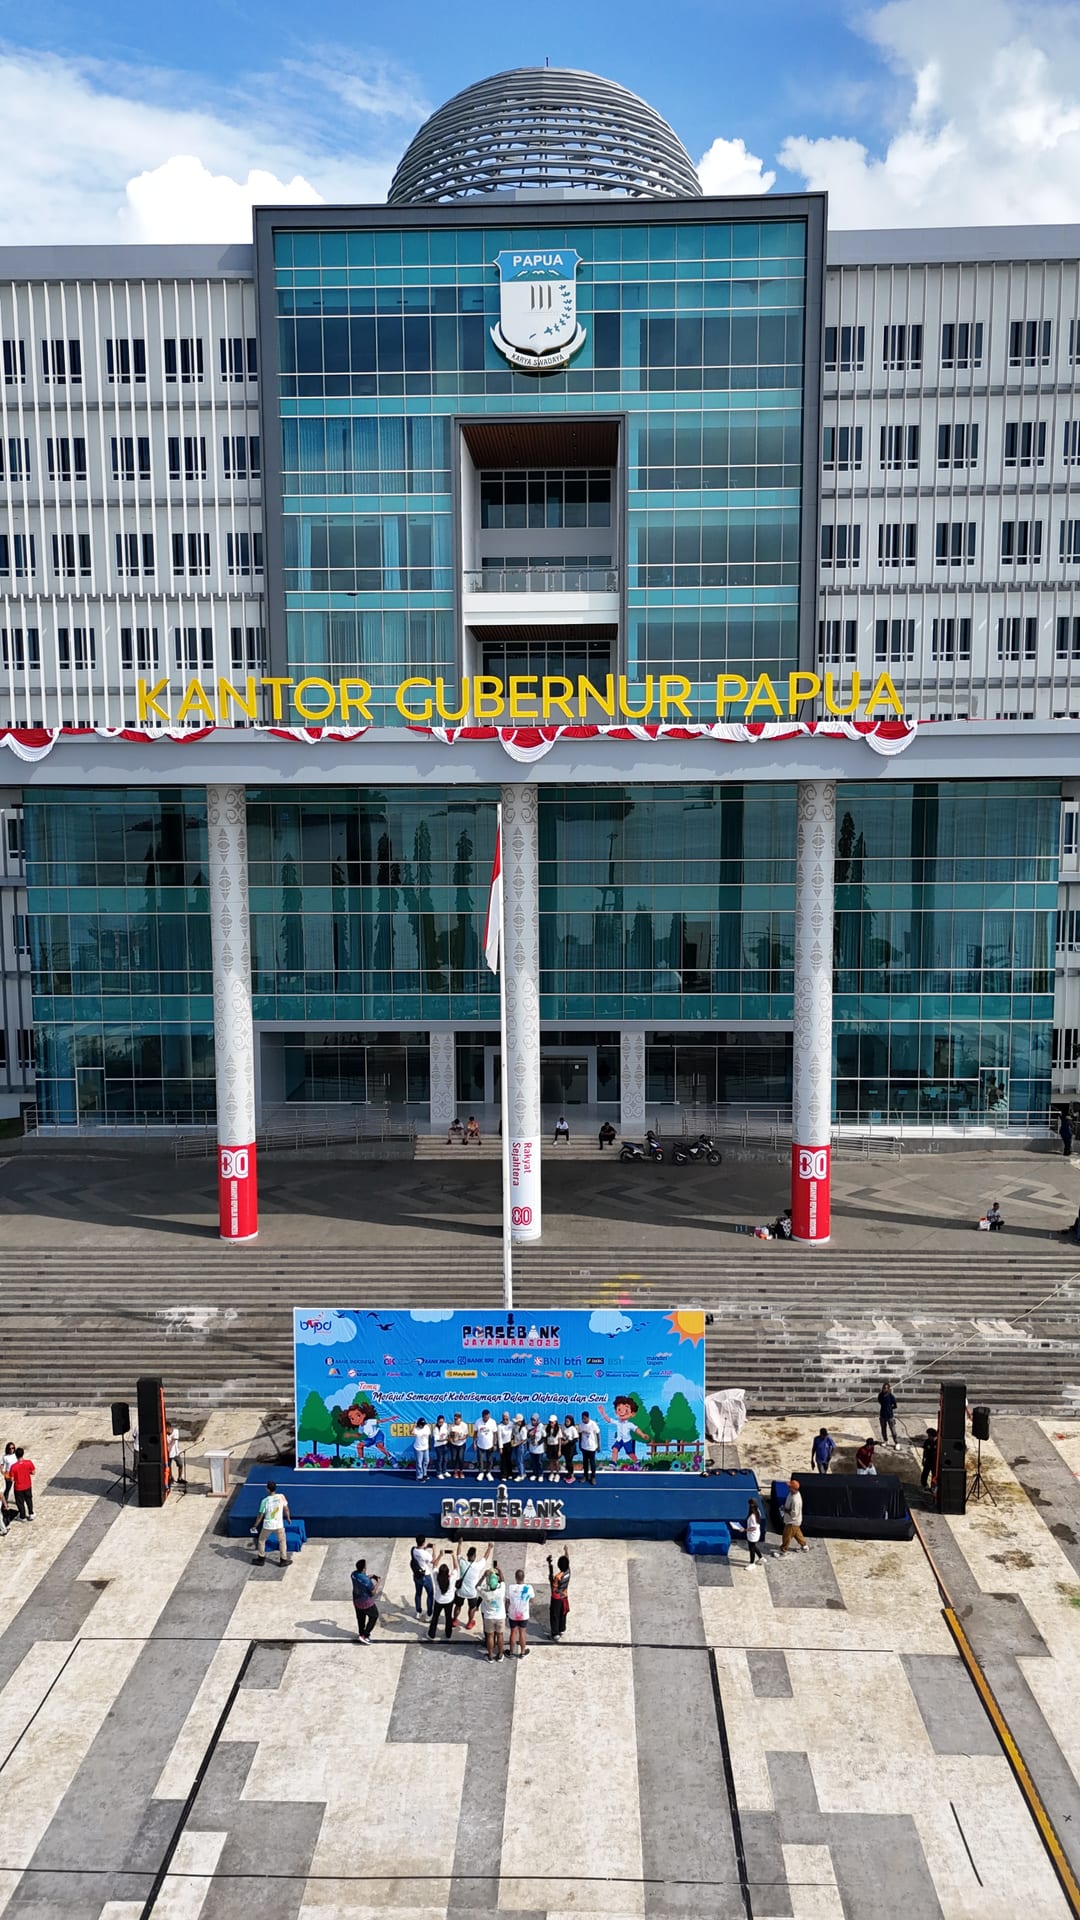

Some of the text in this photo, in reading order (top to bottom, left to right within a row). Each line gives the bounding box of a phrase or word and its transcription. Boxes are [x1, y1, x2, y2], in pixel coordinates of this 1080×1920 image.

[513, 254, 563, 267] PAPUA
[511, 353, 564, 366] KARYA SWADAYA
[138, 671, 905, 721] KANTOR GUBERNUR PAPUA
[512, 1142, 521, 1186] Sejahtera
[522, 1142, 532, 1174] Rakyat
[543, 1357, 560, 1365] BNI
[564, 1356, 582, 1365] btn
[359, 1382, 378, 1391] Tema
[373, 1391, 608, 1403] Merajut Semangat Kebersamaan Dalam Olahraga dan Seni
[443, 1517, 560, 1527] JAYAPURA 2025
